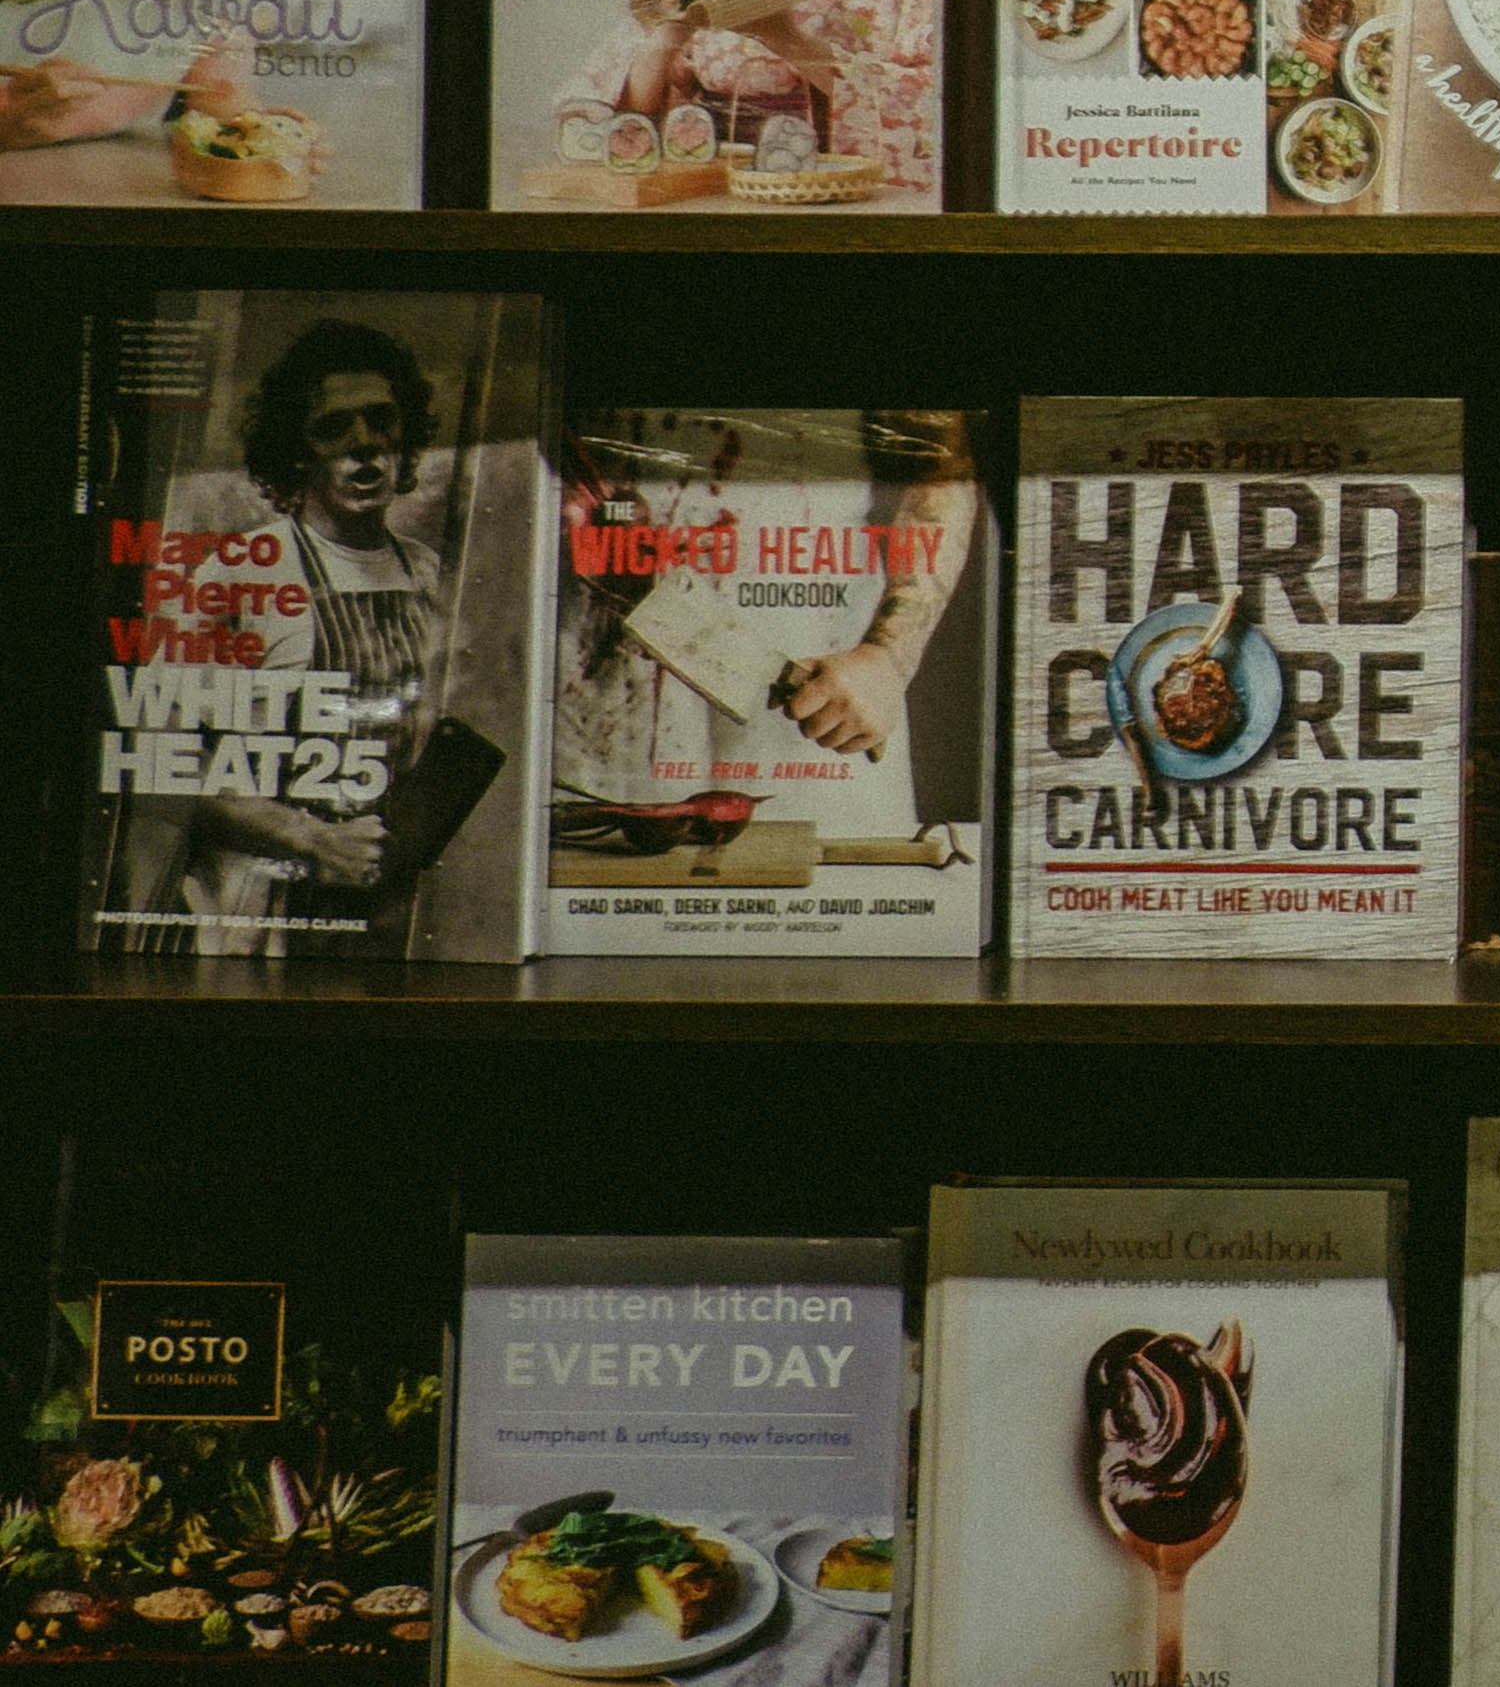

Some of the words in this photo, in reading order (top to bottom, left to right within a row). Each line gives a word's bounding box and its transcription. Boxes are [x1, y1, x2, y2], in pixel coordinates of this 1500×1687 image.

[1025, 127, 1243, 168] Repertoire
[604, 501, 635, 522] THE
[109, 520, 282, 565] Marco
[570, 525, 737, 576] WICKED
[760, 525, 943, 576] HEALTHY
[1048, 480, 1425, 625] HARD
[143, 570, 308, 617] Pierre
[737, 581, 848, 610] COOKBOOK
[107, 617, 264, 667] White
[106, 664, 351, 733] WHITE
[100, 734, 390, 801] HEAT25
[1045, 785, 1421, 852] CARNIVORE
[127, 1336, 250, 1363] POSTO
[502, 1342, 704, 1387] EVERY
[731, 1343, 856, 1389] DAY
[497, 1427, 607, 1448] triumphant
[615, 1427, 629, 1445] &
[637, 1427, 711, 1449] unfussy
[719, 1432, 759, 1446] new
[765, 1427, 852, 1446] favorites
